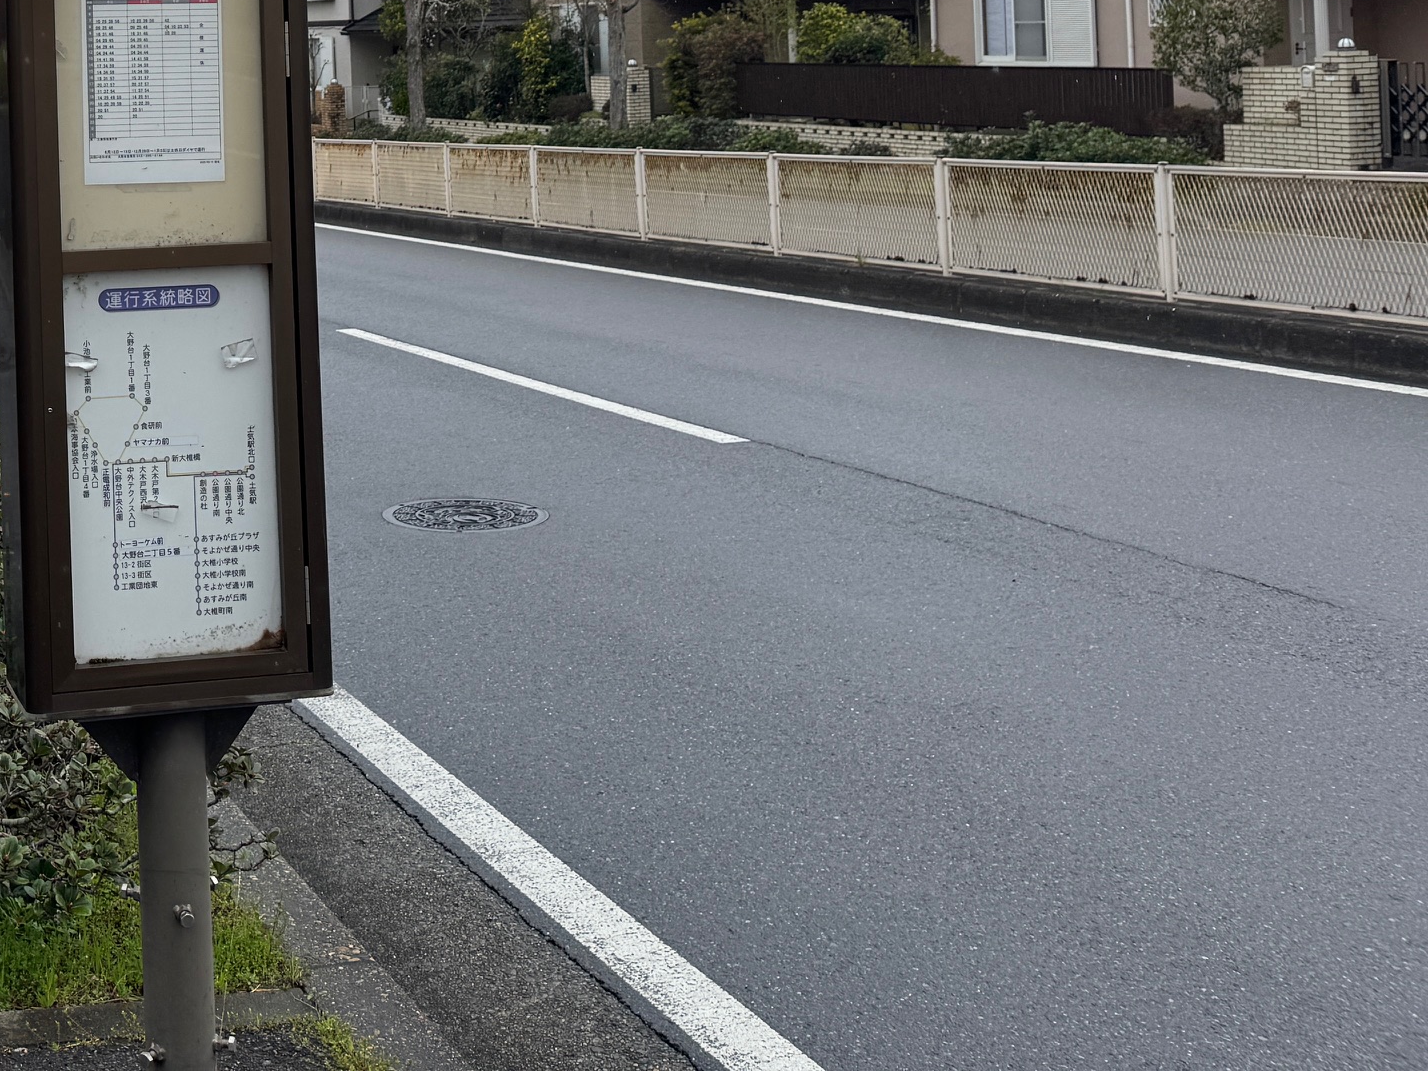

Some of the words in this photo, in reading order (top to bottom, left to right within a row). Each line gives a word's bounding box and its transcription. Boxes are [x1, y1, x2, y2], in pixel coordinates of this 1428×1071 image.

[106, 288, 211, 309] 運行系統略図
[83, 340, 91, 393] 小池工業前
[127, 331, 135, 391] 大野台1丁目1番
[143, 344, 151, 404] 大野台1丁目3番
[133, 438, 169, 446] ヤマナカ前
[115, 468, 123, 521] 大野台中央公園
[127, 467, 135, 527] 中外テクノス入口
[199, 480, 207, 509] 創造の杜
[212, 479, 220, 516] 公園通り南
[224, 478, 233, 523] 公園通り中央
[249, 482, 257, 504] 土気駅
[120, 537, 163, 548] トーヨーケム前
[201, 532, 259, 542] あすみが丘プラザ
[202, 545, 260, 554] そよかぜ通り中央
[137, 560, 151, 568] 街区
[202, 558, 238, 567] 大椎小学校
[203, 570, 246, 579] 大椎小学校南
[122, 581, 158, 590] 工業団地東
[204, 581, 253, 591] そよかぜ通り南
[204, 594, 247, 603] あすみが丘南
